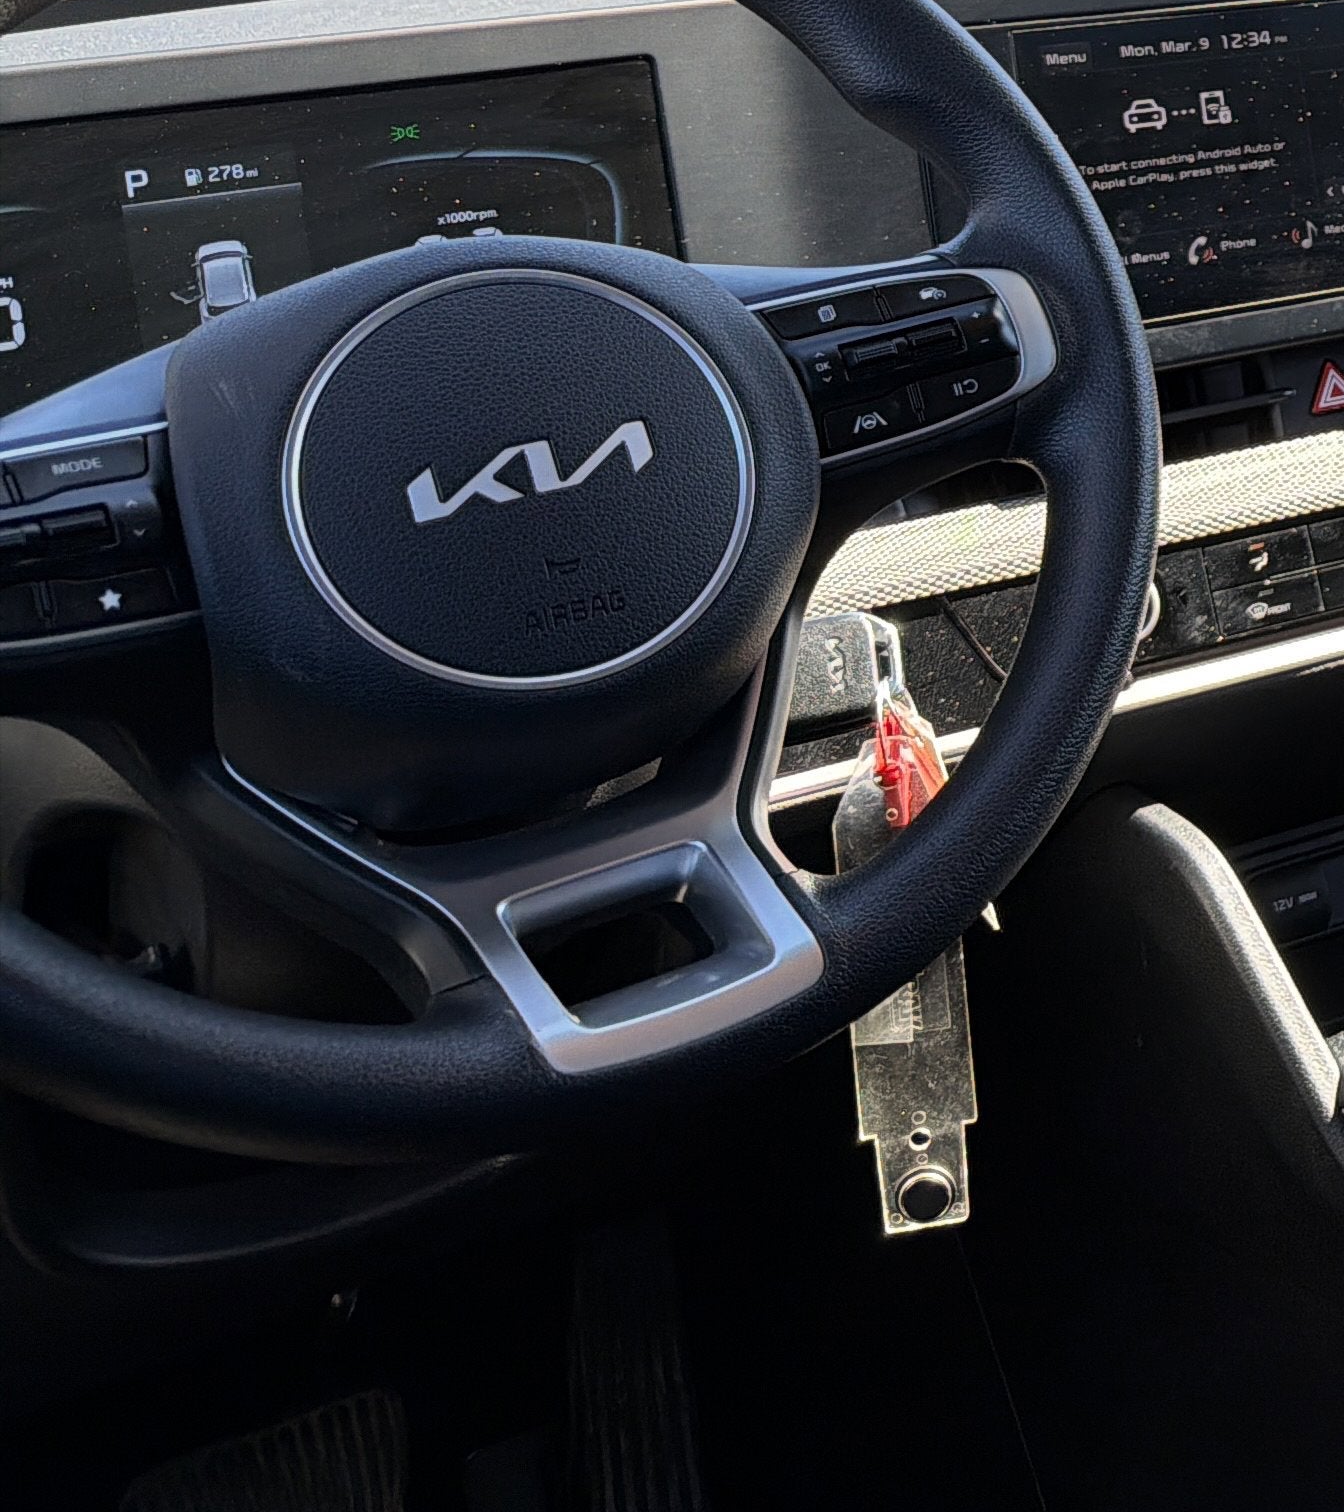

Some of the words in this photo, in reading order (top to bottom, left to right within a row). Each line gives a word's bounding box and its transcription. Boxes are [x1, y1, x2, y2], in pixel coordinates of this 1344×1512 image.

[1199, 37, 1210, 50] 9
[1221, 30, 1271, 50] 12:34
[1045, 52, 1087, 66] Menu
[1080, 165, 1095, 177] To
[1096, 159, 1128, 175] start
[1130, 151, 1195, 171] connecting
[1197, 145, 1242, 161] Android
[1243, 141, 1272, 156] Auto
[1273, 140, 1287, 152] or
[207, 163, 244, 183] 278
[245, 168, 259, 178] mi
[1091, 177, 1126, 192] Apple
[1179, 167, 1213, 182] press
[1214, 162, 1238, 175] this
[124, 169, 149, 198] P
[437, 209, 499, 226] x1000rpm
[1220, 236, 1257, 251] Phone
[1131, 251, 1170, 264] Menus
[815, 361, 832, 372] OK
[52, 457, 103, 476] MODE
[524, 590, 625, 638] AIRBAG
[1272, 896, 1294, 912] 12V
